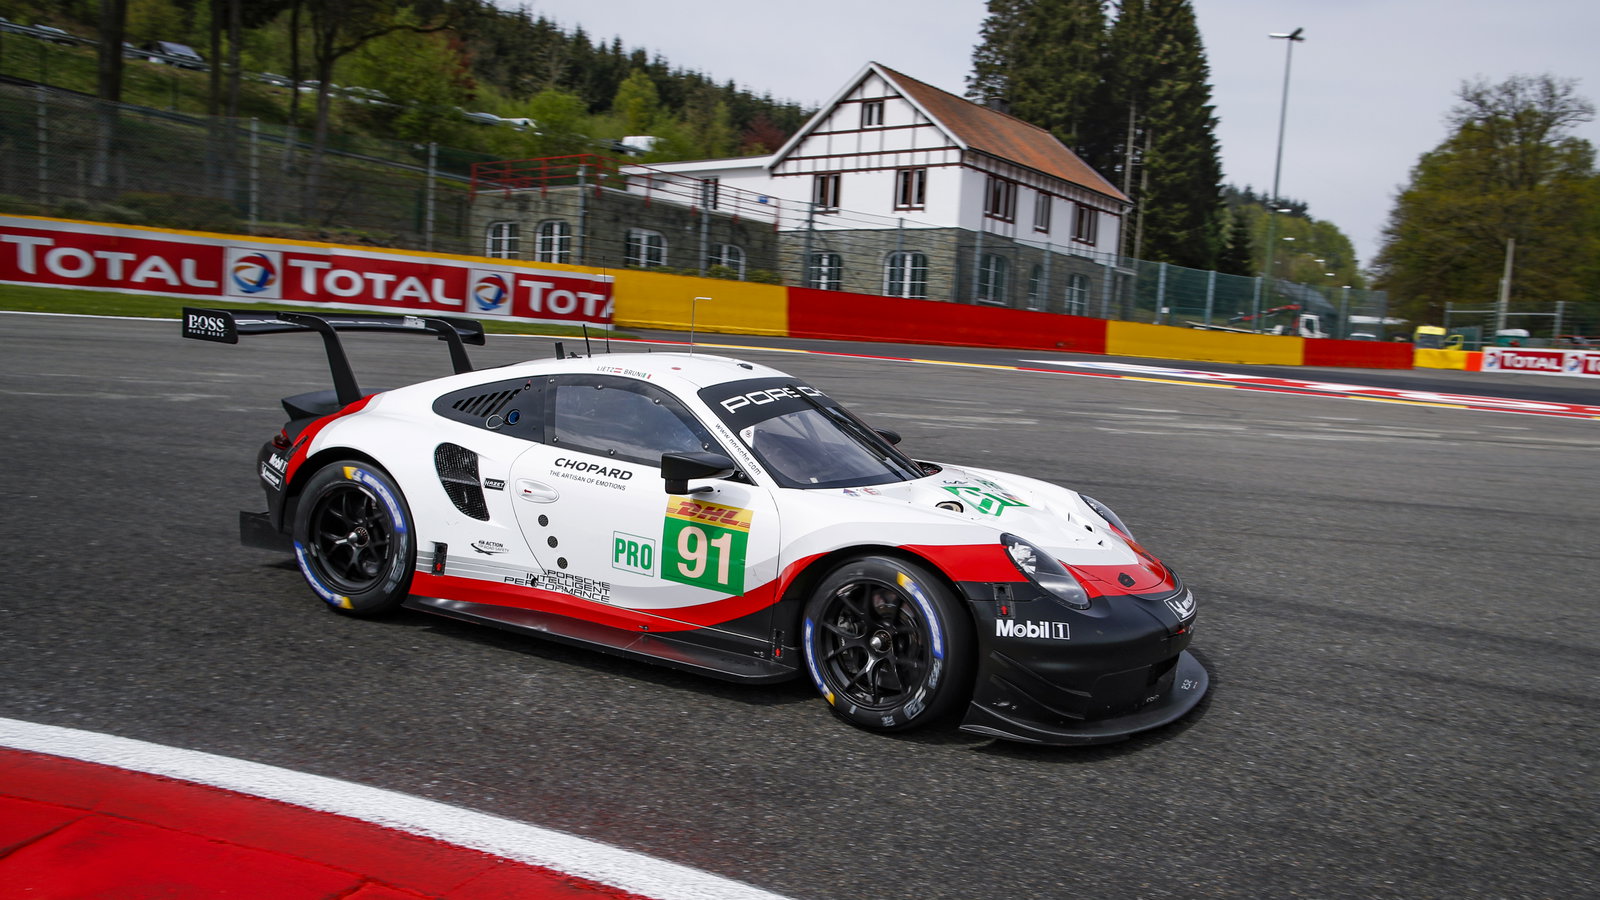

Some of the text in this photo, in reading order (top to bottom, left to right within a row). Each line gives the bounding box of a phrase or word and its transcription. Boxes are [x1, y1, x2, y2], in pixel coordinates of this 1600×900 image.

[1, 234, 218, 288] TOTAL
[288, 258, 463, 306] TOTAL
[188, 314, 225, 332] BOSS
[1501, 353, 1562, 370] TOTAL
[549, 469, 560, 478] THE
[561, 472, 586, 484] ARTISAN
[595, 479, 626, 491] EMOTIONS
[554, 457, 633, 481] CHOPARD
[677, 501, 740, 526] DHL
[614, 537, 653, 570] PRO
[677, 525, 732, 585] 91
[504, 576, 610, 602] PERFORMANCE
[526, 573, 610, 595] INTELLIGENT
[547, 569, 610, 588] PORSCHE
[995, 619, 1050, 639] Mobil
